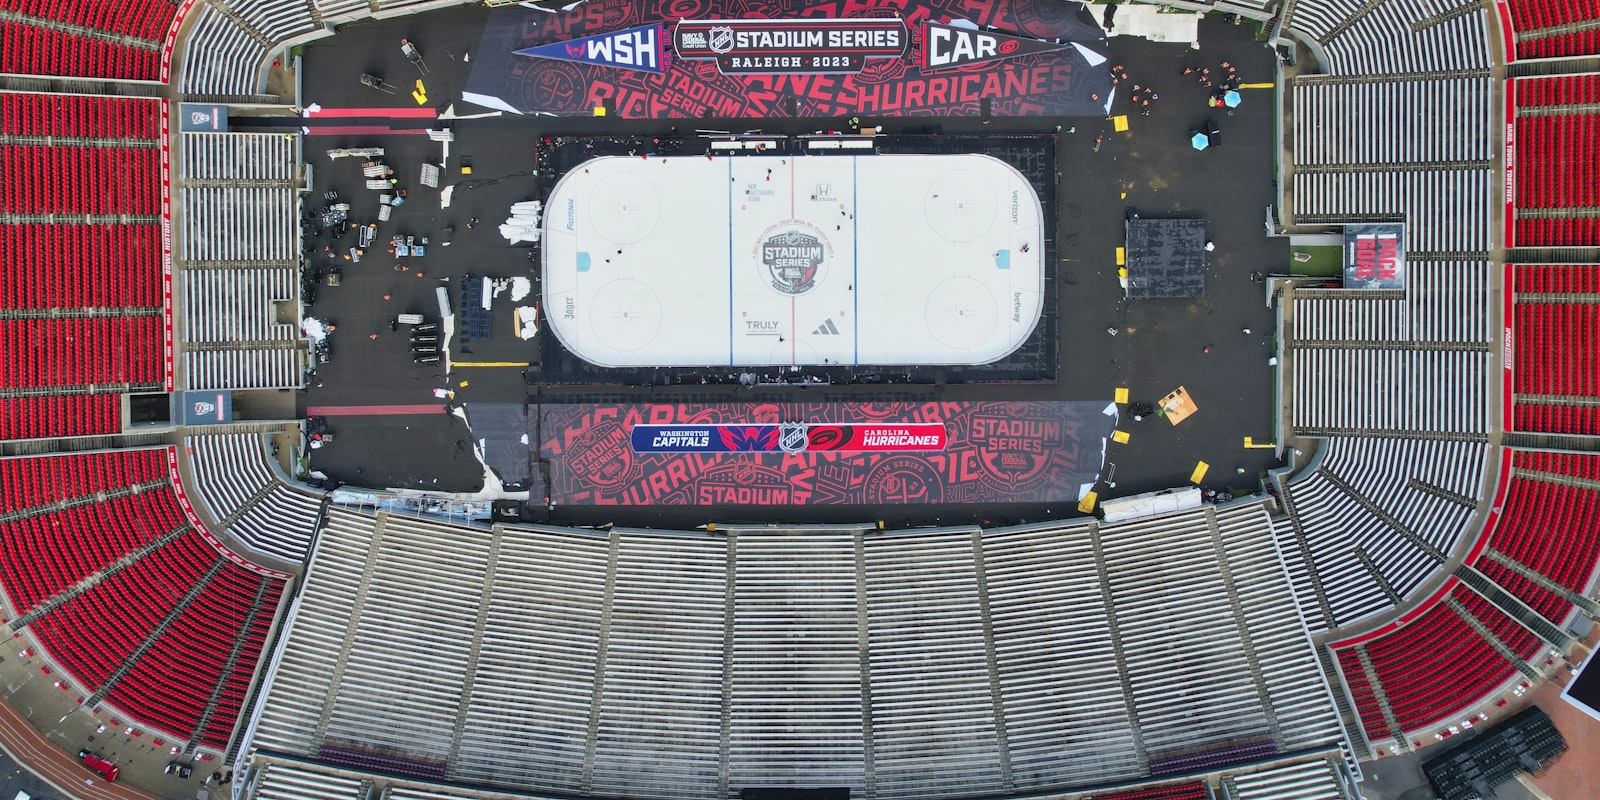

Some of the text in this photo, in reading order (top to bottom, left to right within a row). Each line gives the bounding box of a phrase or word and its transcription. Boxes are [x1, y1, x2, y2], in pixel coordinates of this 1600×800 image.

[521, 3, 604, 40] CAPS
[587, 29, 656, 68] WSH
[714, 31, 730, 48] NHL
[736, 30, 900, 48] STADIUM SERIES
[930, 26, 997, 66] CAR
[732, 56, 850, 68] RALEIGH 2023
[650, 69, 741, 118] STADIUM
[856, 64, 1073, 114] HURRICANES
[660, 88, 716, 118] SERIE
[1011, 190, 1019, 223] verizon
[163, 217, 171, 251] HISTORY
[765, 247, 821, 260] STADIUM
[775, 258, 811, 268] SERIES
[1012, 292, 1022, 323] betway
[746, 321, 779, 329] TRULY
[652, 437, 710, 447] CAPITALS
[785, 429, 803, 447] NHL
[862, 435, 939, 446] HURRICANES
[972, 418, 1060, 442] STADIUM
[571, 427, 626, 475] STADIUM
[988, 438, 1043, 452] SERIES
[587, 445, 623, 474] SERIES
[869, 464, 891, 500] STADIUM
[893, 460, 924, 473] SERIES
[700, 486, 788, 505] STADIUM
